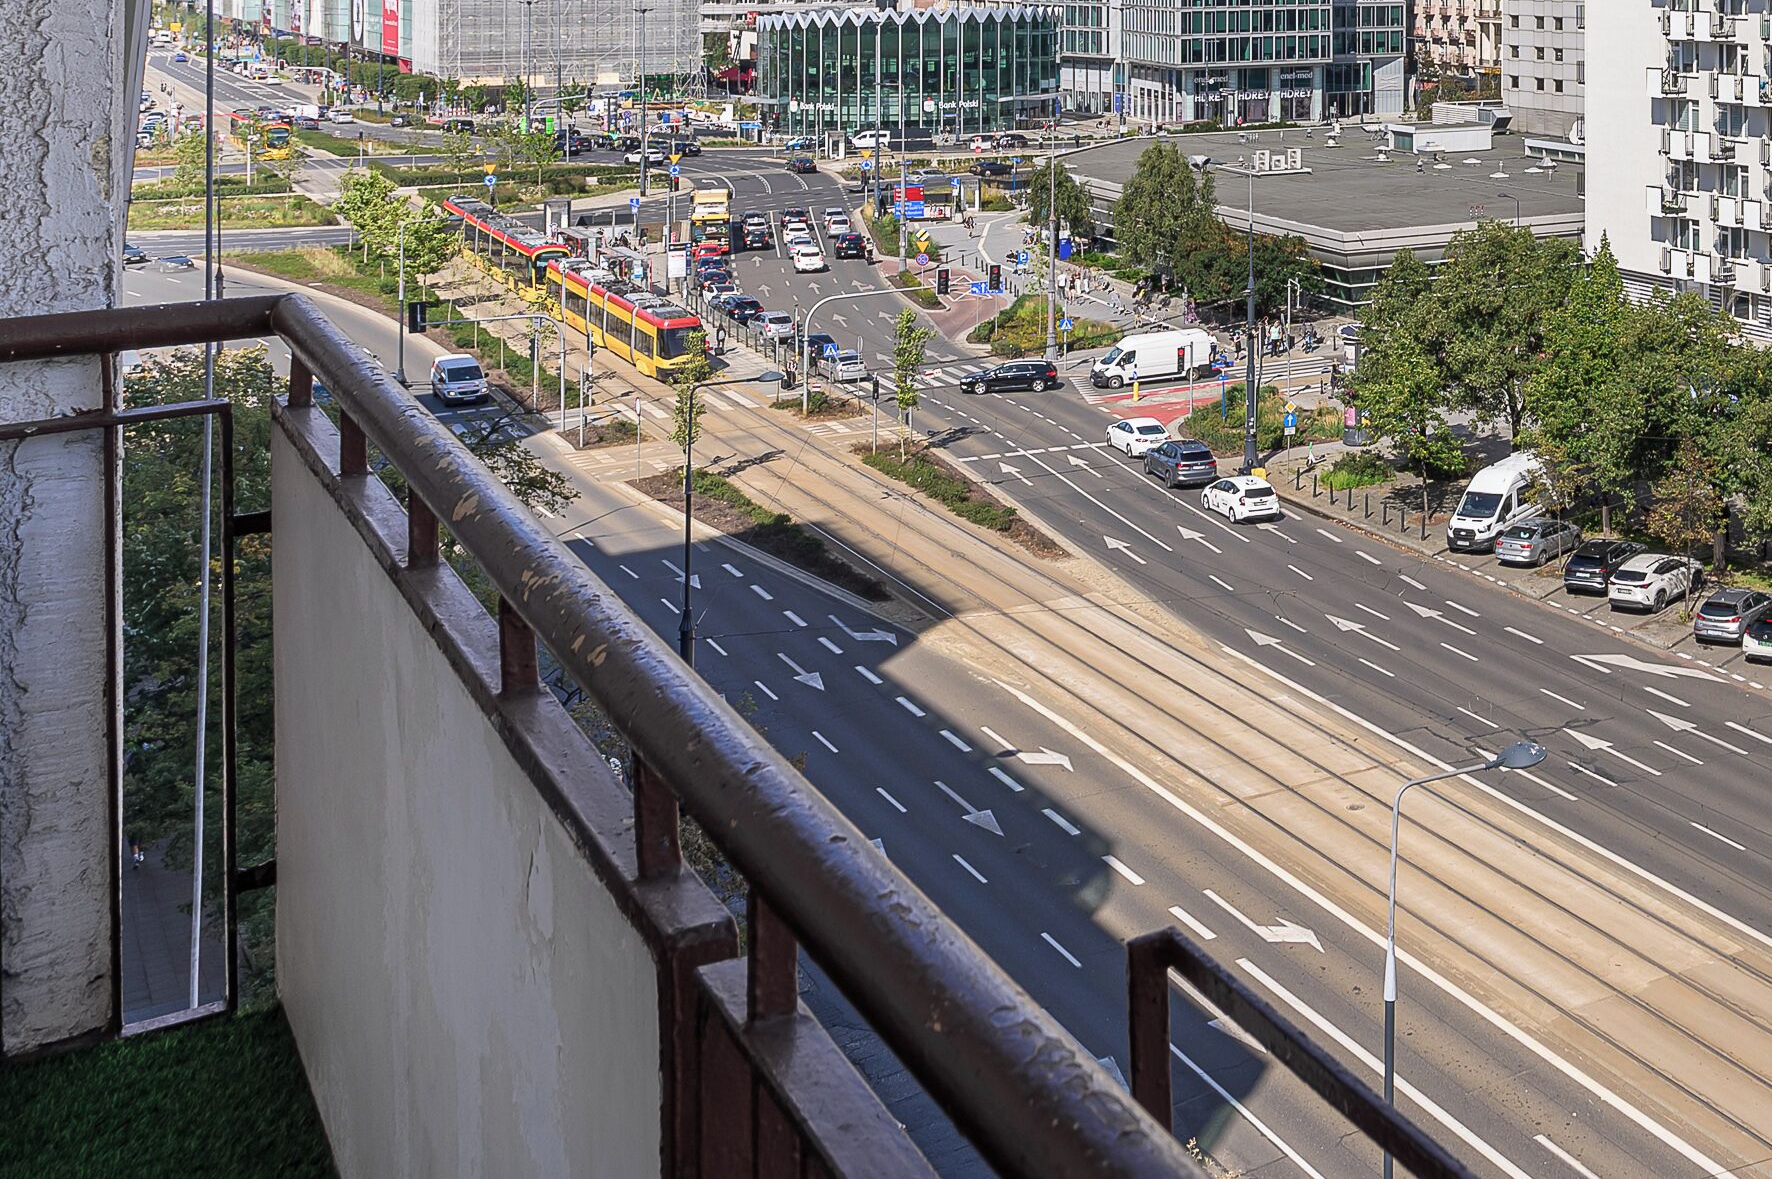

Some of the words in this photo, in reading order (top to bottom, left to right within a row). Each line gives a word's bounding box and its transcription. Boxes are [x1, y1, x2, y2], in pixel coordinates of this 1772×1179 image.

[800, 101, 815, 110] Bank
[816, 102, 834, 110] Polski
[939, 101, 956, 109] Bank
[959, 100, 978, 108] Polski
